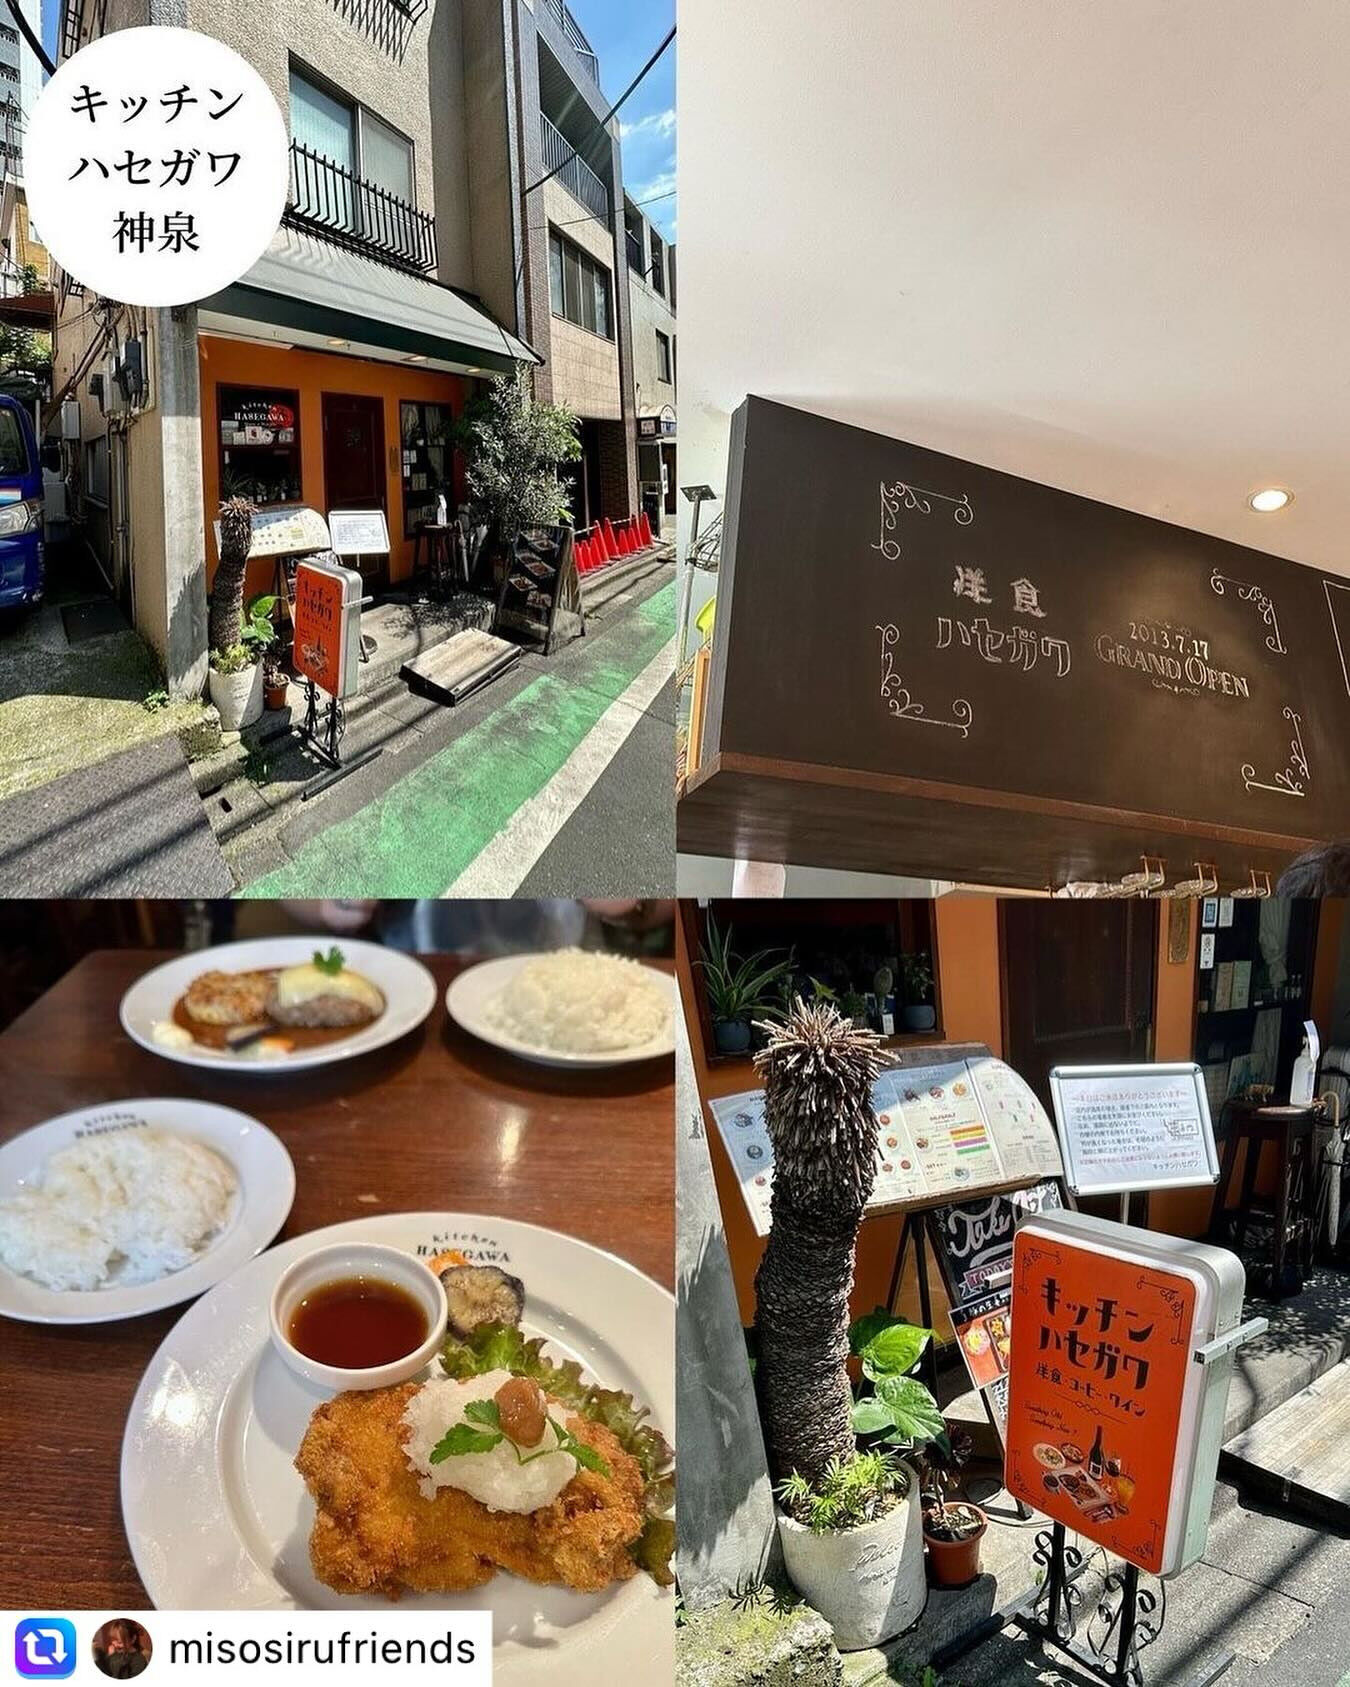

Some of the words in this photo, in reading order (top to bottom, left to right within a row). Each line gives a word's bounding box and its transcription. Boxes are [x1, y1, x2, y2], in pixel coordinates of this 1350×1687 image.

[234, 412, 284, 421] HASEGAWA
[953, 565, 1047, 618] 洋食
[935, 617, 1072, 678] ハセガワ
[1128, 622, 1209, 661] 2013.7.17
[417, 1245, 511, 1262] HAGAWA
[1040, 1277, 1155, 1343] キッチン
[1039, 1323, 1151, 1391] ハセガワ
